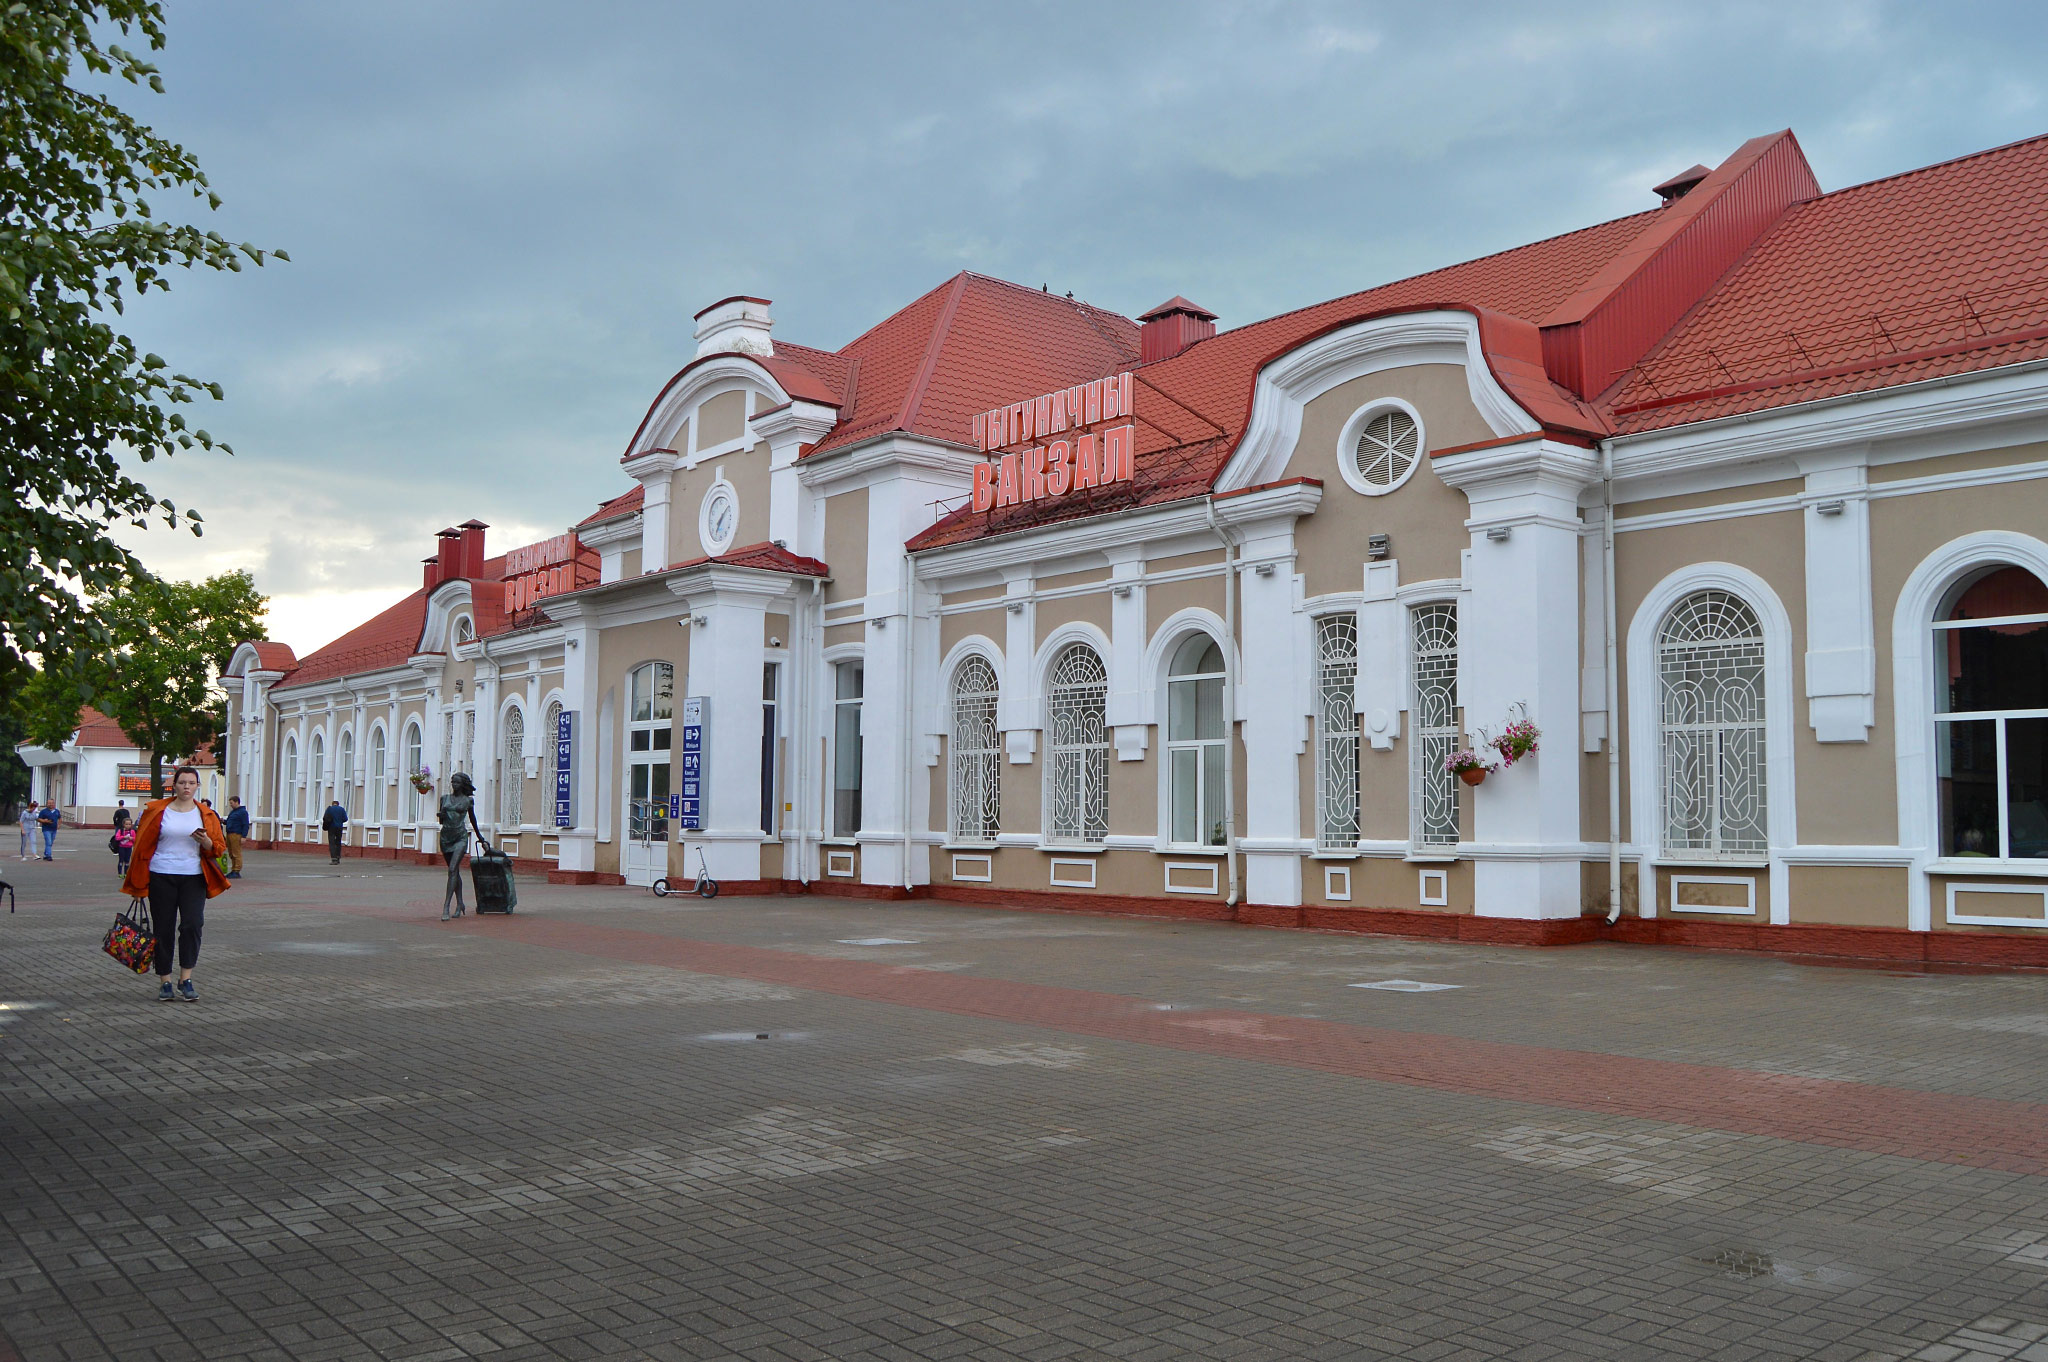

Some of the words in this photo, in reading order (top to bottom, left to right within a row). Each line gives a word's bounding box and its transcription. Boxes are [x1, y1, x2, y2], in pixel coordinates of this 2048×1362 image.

[972, 371, 1133, 453] ЧЫГУНАЧНЫ
[972, 424, 1134, 514] ВАКЗАЛ
[504, 563, 574, 614] ВОКЗАЛ
